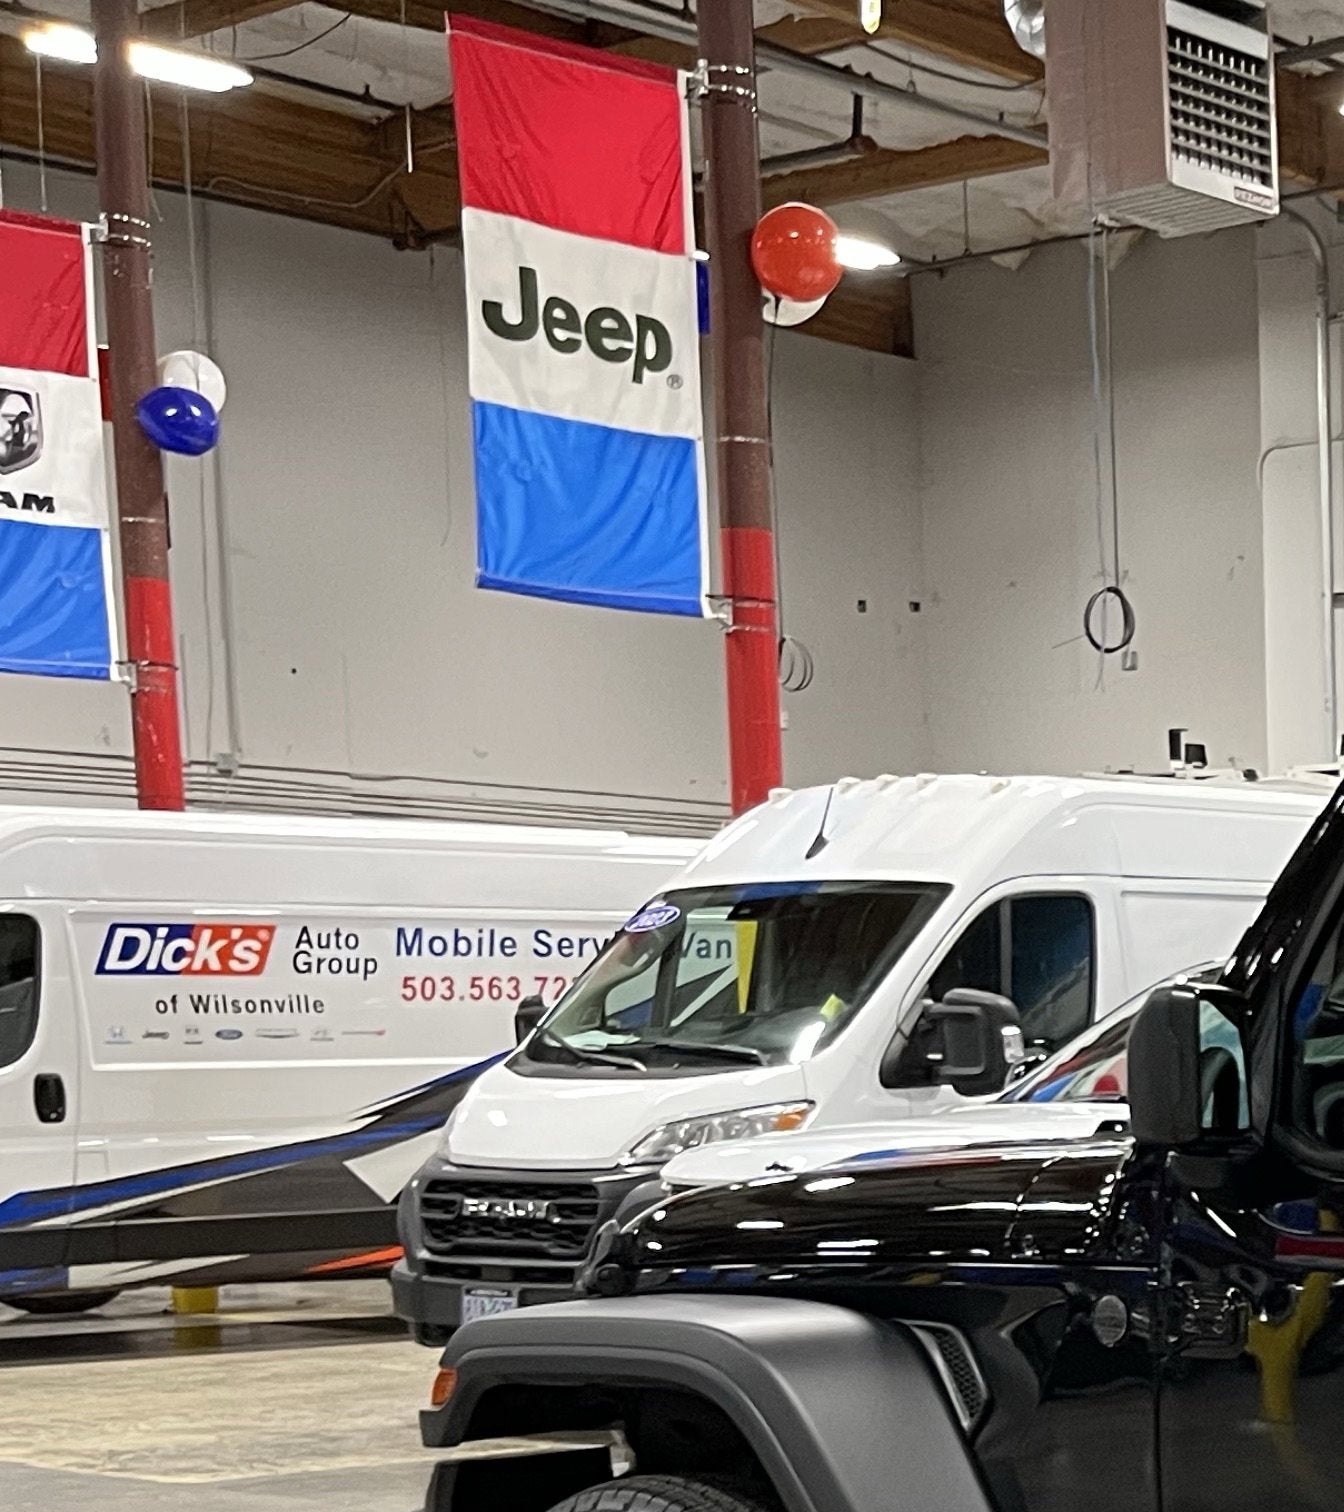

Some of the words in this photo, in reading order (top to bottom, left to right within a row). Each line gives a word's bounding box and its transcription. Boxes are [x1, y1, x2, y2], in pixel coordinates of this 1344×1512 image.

[482, 266, 672, 384] Jeep
[0, 490, 56, 514] AM
[104, 926, 264, 972] Dick's
[295, 926, 359, 950] Auto
[395, 928, 518, 958] Mobile
[292, 951, 378, 981] Group
[155, 994, 178, 1014] of
[189, 994, 325, 1014] Wilsonville
